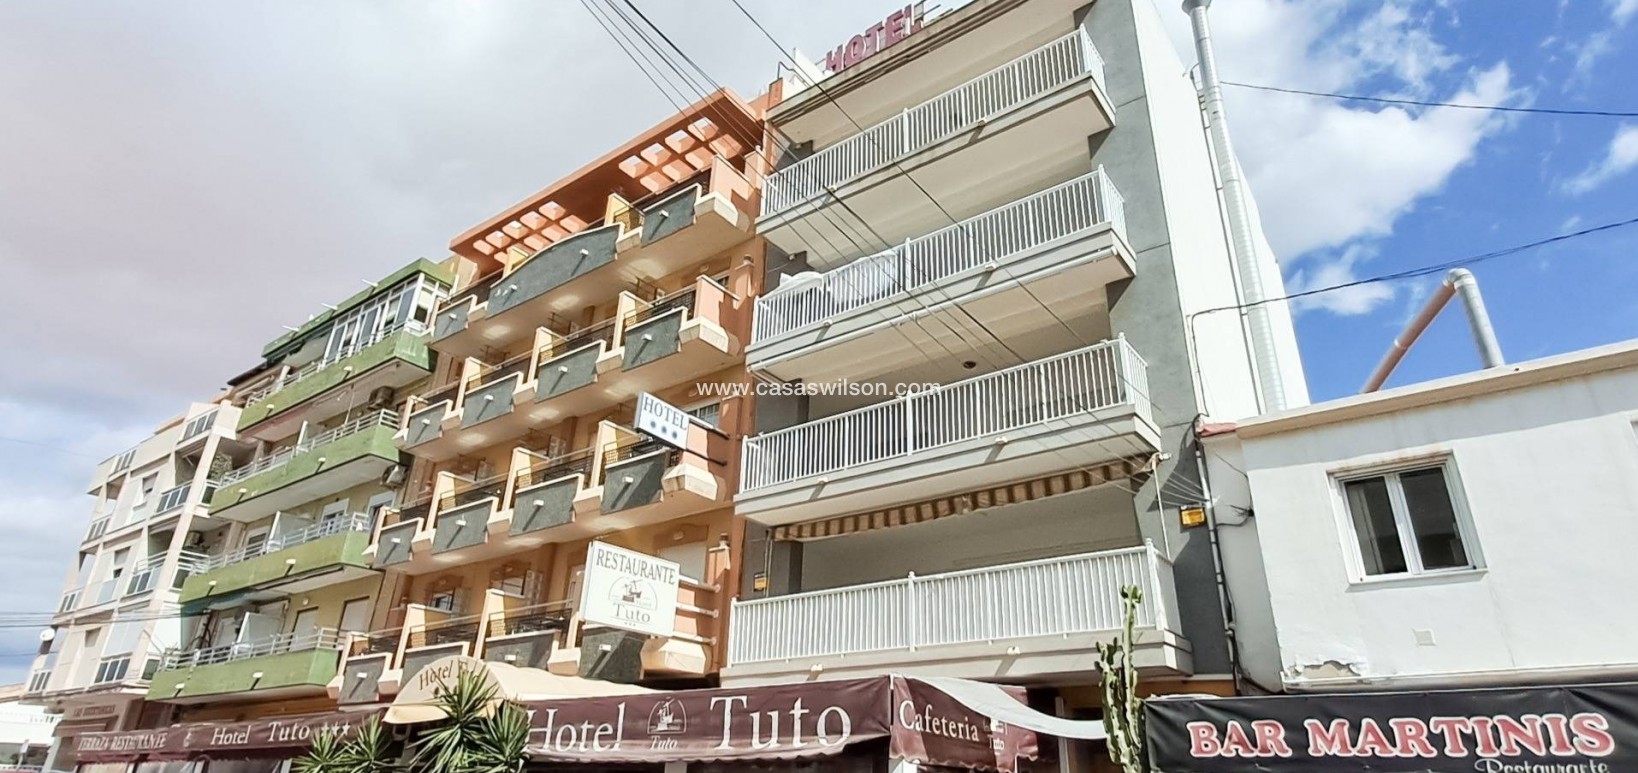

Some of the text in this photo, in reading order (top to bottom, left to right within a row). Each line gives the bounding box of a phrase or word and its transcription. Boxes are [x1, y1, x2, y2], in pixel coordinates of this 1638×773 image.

[643, 395, 688, 432] HOTEL
[596, 548, 676, 586] RESTAURANTE
[613, 602, 650, 623] Tuto
[419, 660, 454, 690] Hotel
[210, 721, 311, 746] Hotel Tuto
[521, 695, 852, 752] Hotel Tuto
[900, 700, 979, 742] Cafeteria
[1186, 712, 1616, 758] BAR MARTINIS
[651, 735, 678, 750] Tuto
